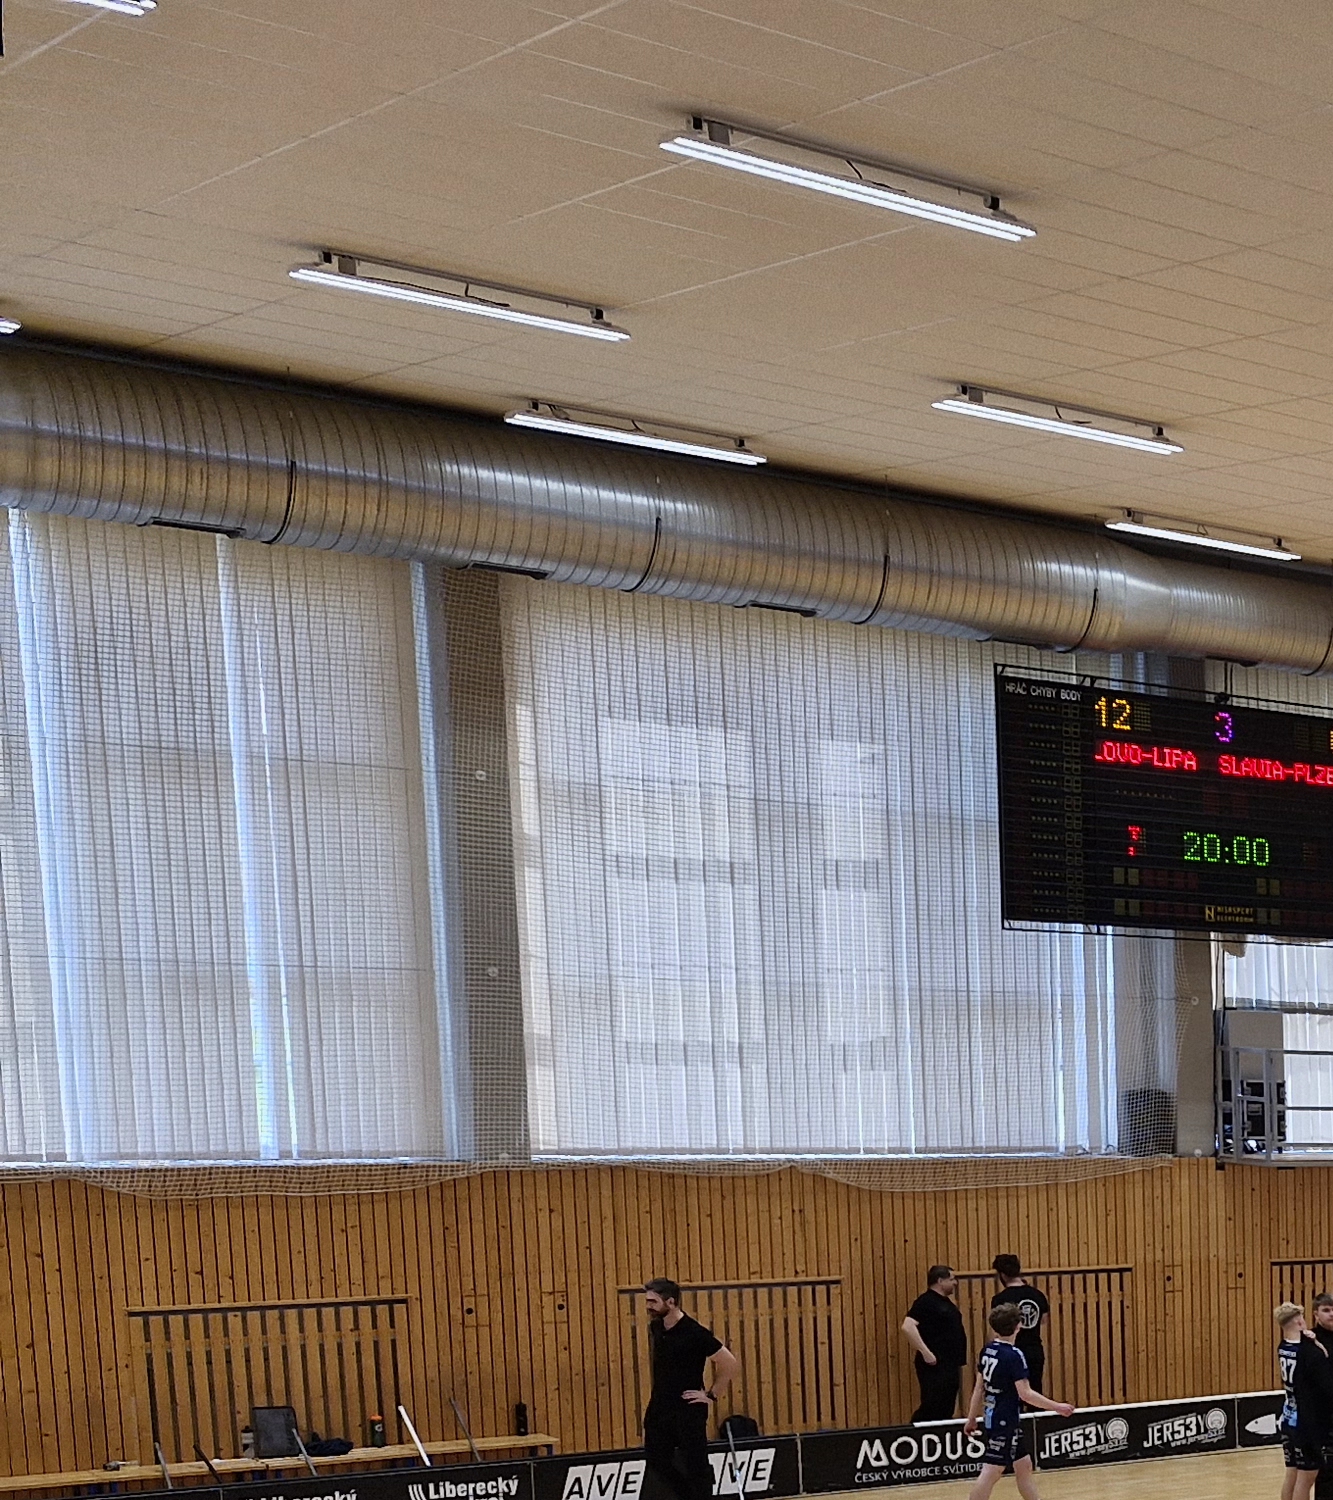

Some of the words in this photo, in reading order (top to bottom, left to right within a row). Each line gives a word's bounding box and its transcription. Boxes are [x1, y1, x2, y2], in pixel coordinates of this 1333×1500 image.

[1030, 685, 1057, 698] CHYBY
[1060, 688, 1082, 701] BODY
[1095, 696, 1131, 730] 12
[1214, 711, 1234, 743] 3
[1184, 832, 1270, 866] 20:00
[982, 1356, 999, 1382] 27
[856, 1430, 986, 1470] MODUS
[428, 1475, 519, 1500] Liberecký
[854, 1471, 889, 1484] ČESKÝ
[891, 1466, 941, 1479] VÝROBCE
